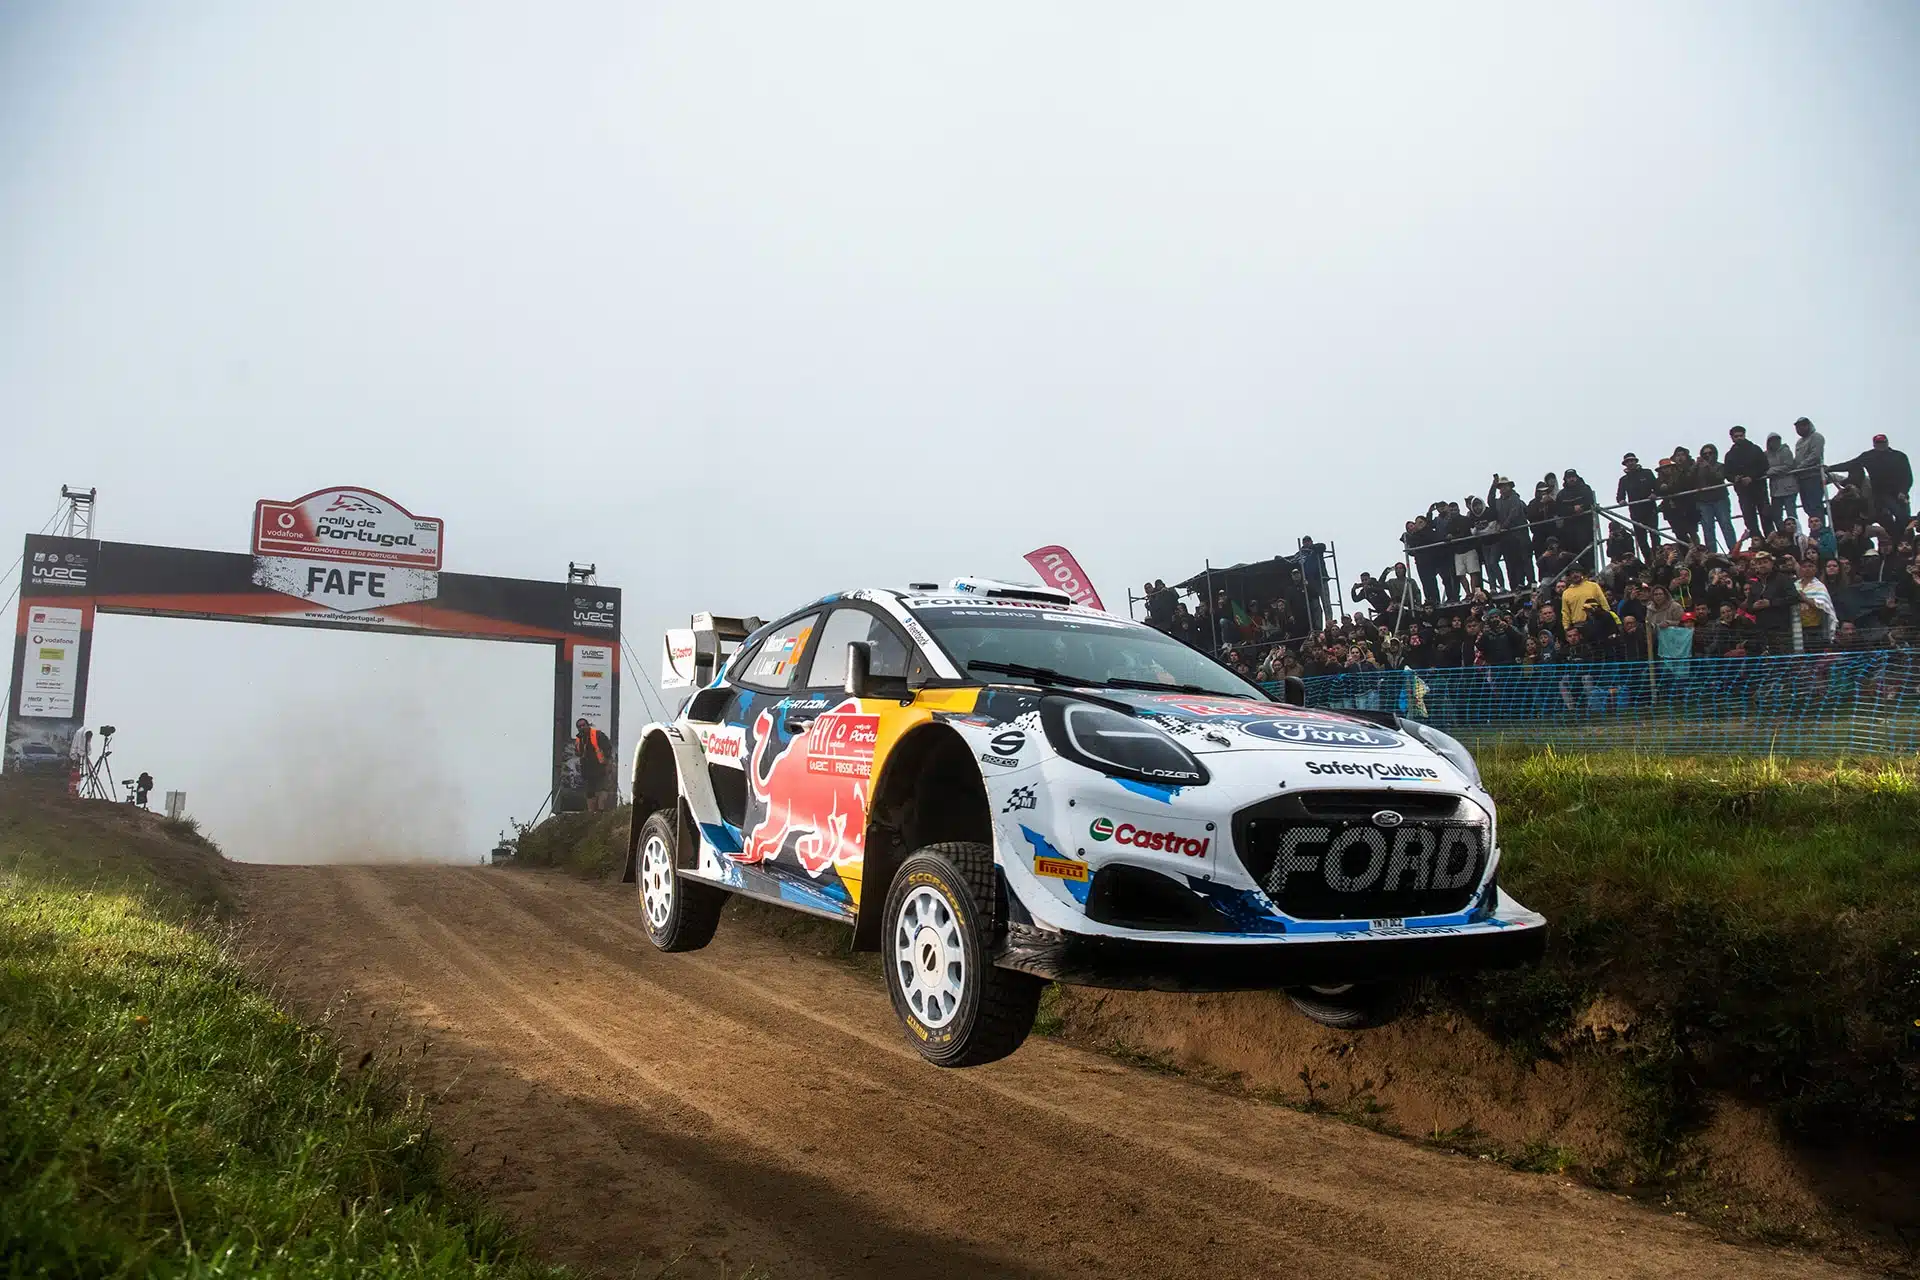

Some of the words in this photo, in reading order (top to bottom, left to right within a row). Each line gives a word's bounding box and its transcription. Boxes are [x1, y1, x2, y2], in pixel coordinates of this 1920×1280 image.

[318, 516, 354, 528] rally
[357, 519, 376, 528] de
[267, 529, 304, 539] vodafone
[315, 525, 417, 547] Portugal
[302, 545, 340, 555] AUTOMÓVEL
[366, 551, 398, 560] PORTUGAL
[32, 565, 87, 581] WRC
[307, 566, 386, 598] FAFE
[305, 611, 385, 623] www.rallydeportugal.pt
[573, 610, 614, 623] WRC
[45, 637, 73, 645] vodafone
[1272, 721, 1381, 746] Ford
[708, 733, 741, 758] Castrol
[984, 754, 1017, 767] sparco
[1115, 823, 1210, 858] Castrol
[1266, 827, 1478, 893] FORD
[1039, 860, 1084, 879] PIRELLI
[908, 873, 965, 926] SCORPION
